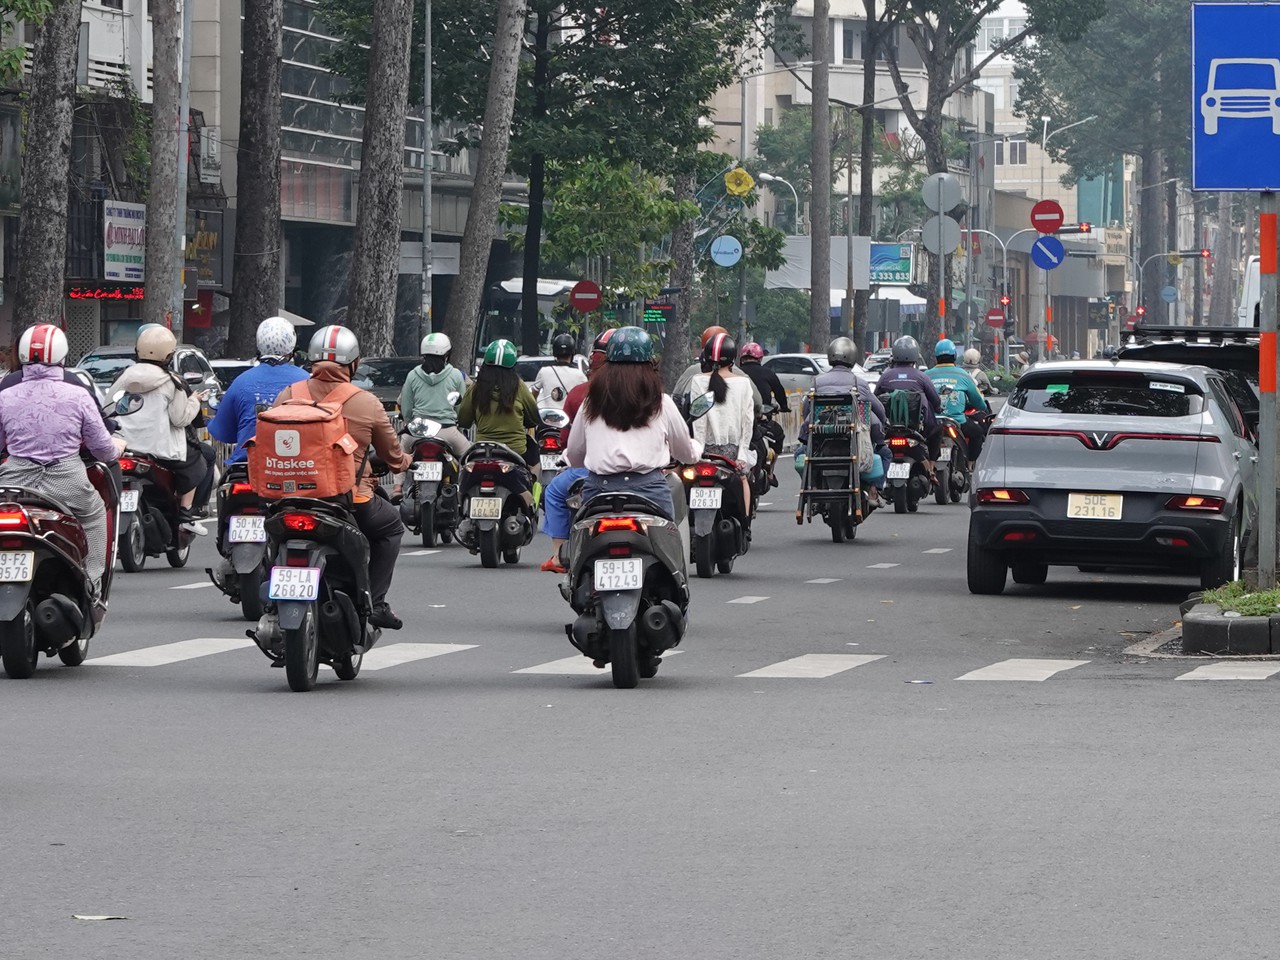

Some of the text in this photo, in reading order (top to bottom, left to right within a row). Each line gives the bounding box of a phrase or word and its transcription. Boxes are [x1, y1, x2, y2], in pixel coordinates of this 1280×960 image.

[266, 457, 315, 469] bTaskee
[695, 490, 716, 498] 50-X1
[691, 499, 719, 508] 026.31
[1084, 495, 1107, 506] 50E
[1074, 505, 1115, 517] 231.16
[236, 518, 262, 529] 50-N2
[231, 530, 265, 540] 047.53
[0, 553, 27, 566] 9-F2
[602, 561, 635, 574] 59-L3
[278, 570, 311, 583] 59-LA
[599, 575, 638, 589] 412.49
[273, 584, 314, 598] 268.20
